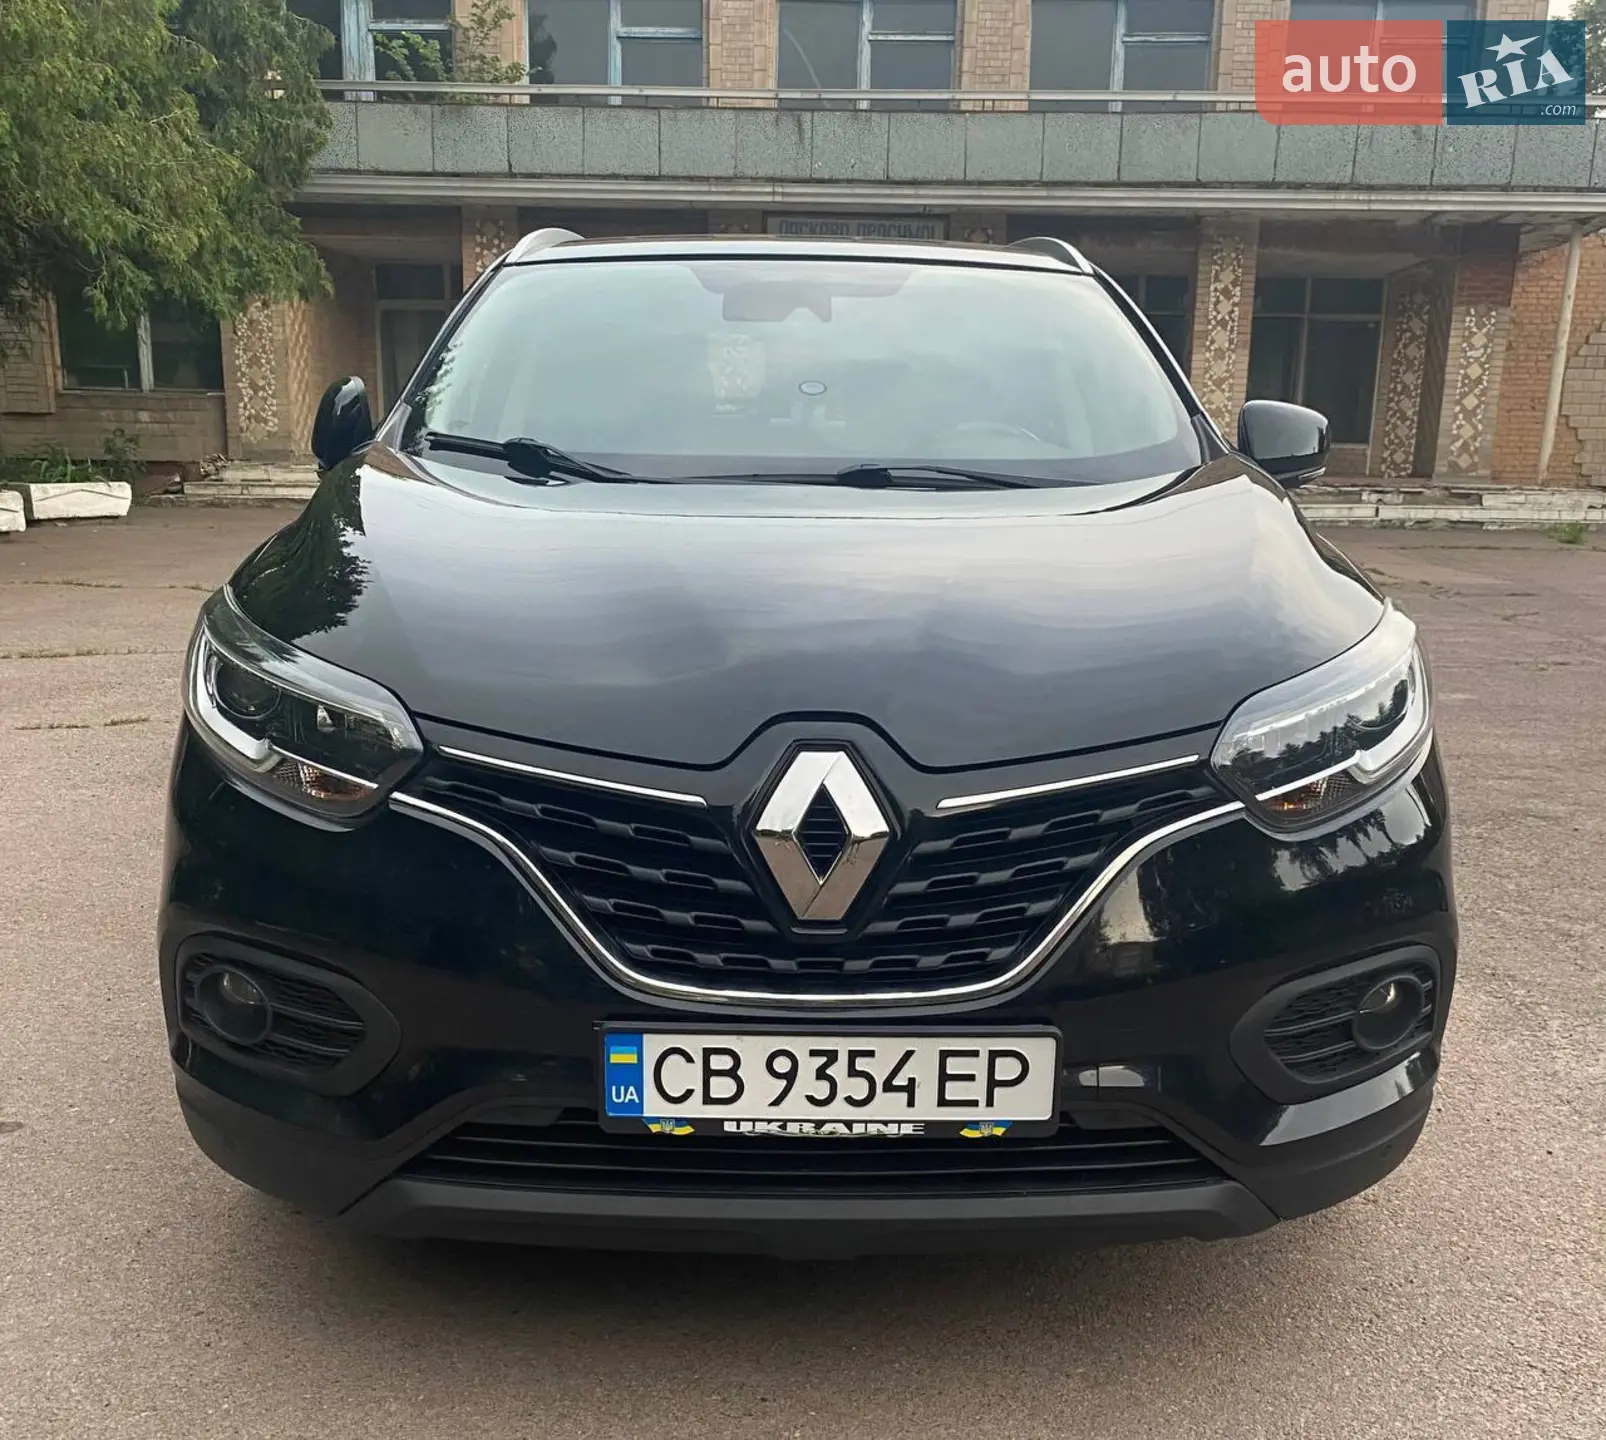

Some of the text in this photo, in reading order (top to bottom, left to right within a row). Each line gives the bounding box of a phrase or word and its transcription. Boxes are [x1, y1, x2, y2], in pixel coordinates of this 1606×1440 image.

[653, 1046, 1030, 1108] CB 9354 EP
[611, 1085, 639, 1104] UA
[723, 1120, 926, 1136] UKRAINE
